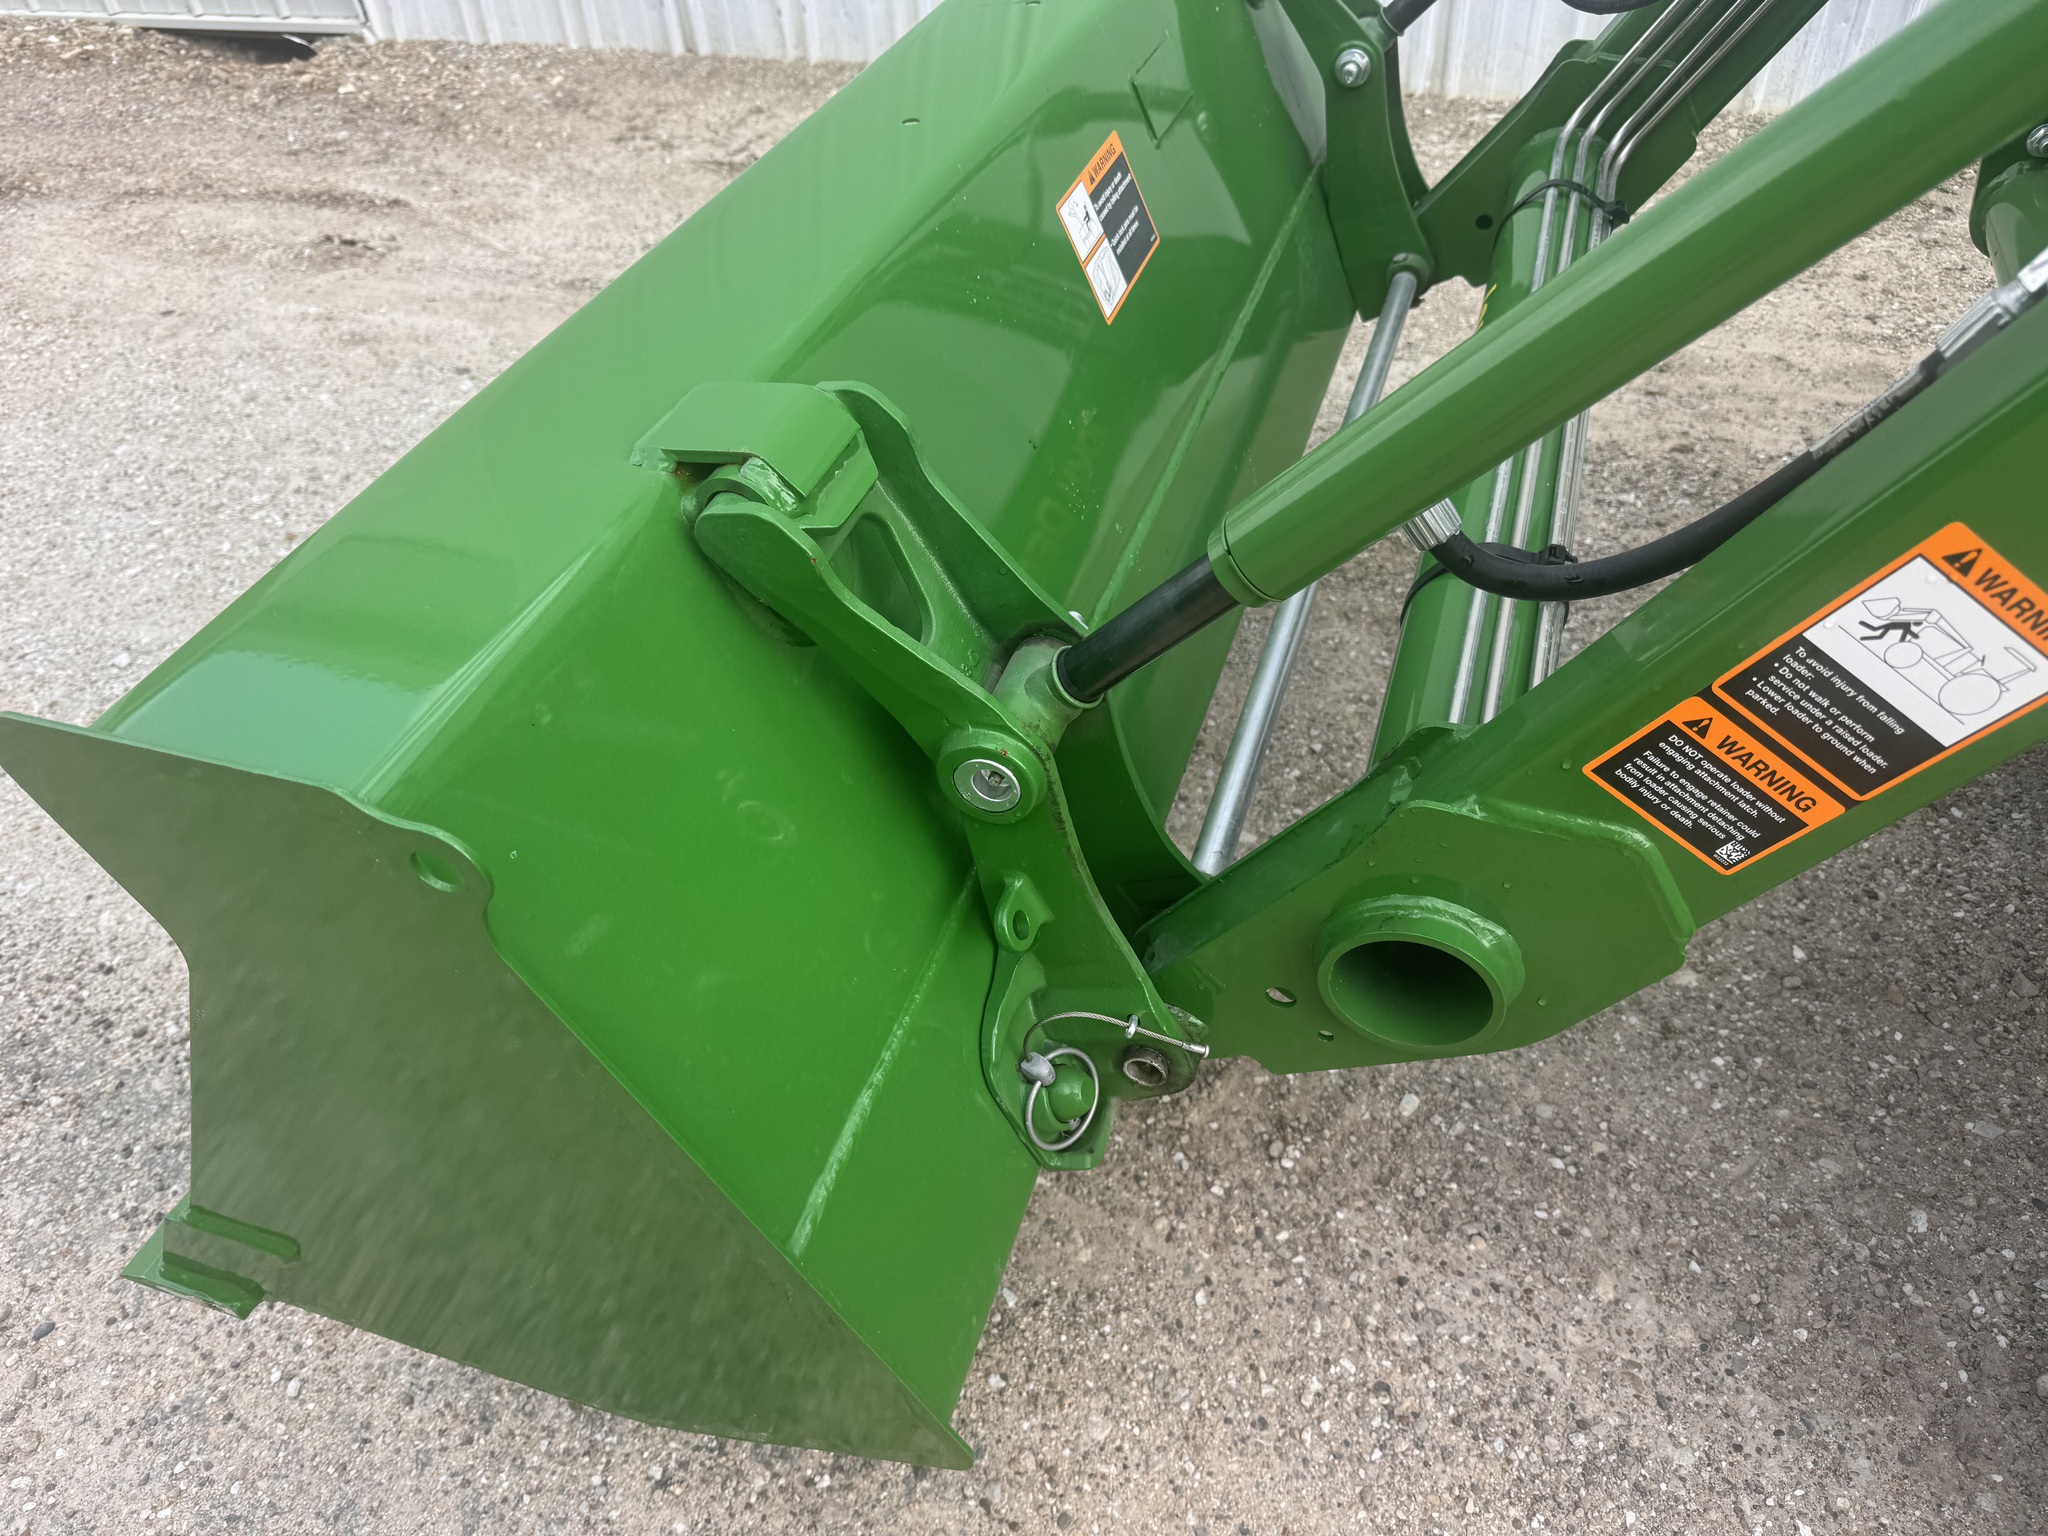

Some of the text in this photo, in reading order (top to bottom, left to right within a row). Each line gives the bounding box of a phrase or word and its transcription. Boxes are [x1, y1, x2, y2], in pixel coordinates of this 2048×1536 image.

[1092, 143, 1116, 177] WARNING
[1975, 567, 2048, 640] WARNI
[1745, 689, 1780, 715] parked.
[1778, 666, 1875, 742] Do not walk or perform
[1783, 654, 1815, 680] loader:
[1795, 646, 1905, 735] To avoid injury from falling
[1757, 681, 1876, 774] Lower loader to ground when
[1768, 675, 1800, 700] service
[1800, 699, 1827, 719] under
[1832, 725, 1862, 746] raised
[1859, 744, 1888, 769] loader.
[1615, 769, 1640, 788] bodily
[1638, 786, 1662, 804] injury
[1670, 810, 1692, 829] death.
[1624, 763, 1726, 839] from loader causing serious
[1633, 757, 1745, 841] result in attachment detaching
[1643, 750, 1761, 838] Failure to engage retainer could
[1659, 742, 1758, 818] engaging attachment latch.
[1668, 734, 1786, 823] DO NOT operate loader without
[1716, 735, 1817, 813] WARNING
